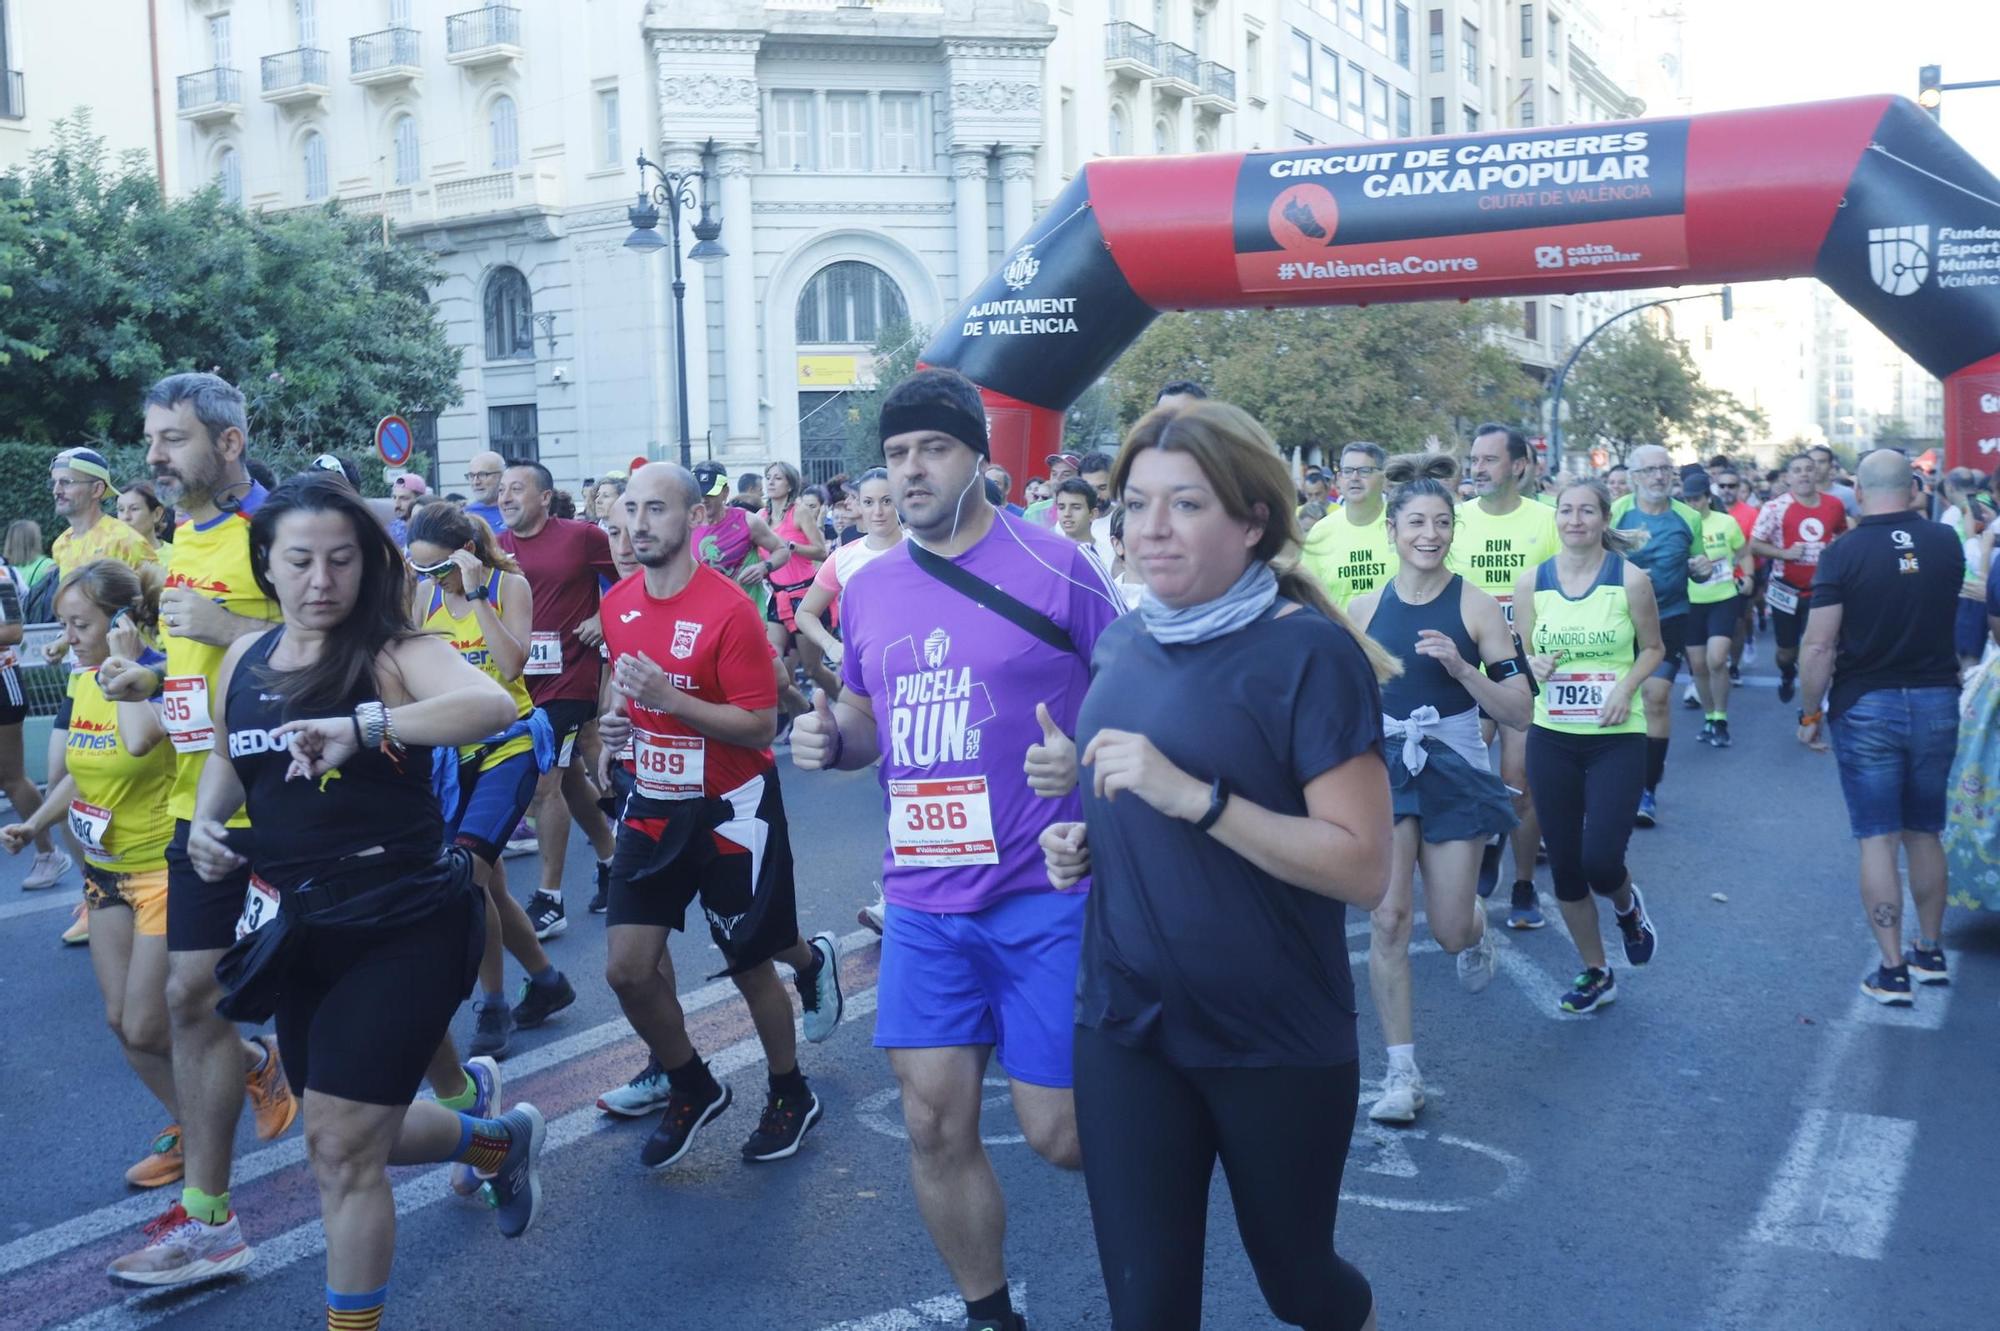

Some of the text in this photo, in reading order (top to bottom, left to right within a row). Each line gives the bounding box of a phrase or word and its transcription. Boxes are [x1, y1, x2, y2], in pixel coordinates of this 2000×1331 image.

[1269, 132, 1648, 178] CIRCUIT DE CARRERES
[1363, 155, 1649, 198] CAIXA POPULAR
[1478, 184, 1651, 210] CIUTAT DE VALÈNCIA
[1938, 226, 2000, 240] Funda
[1566, 244, 1614, 256] caixa
[1567, 252, 1641, 267] popular
[1277, 256, 1478, 280] #ValènciaCorre
[967, 298, 1077, 318] AJUNTAMENT
[962, 316, 1079, 336] DE VALÈNCIA
[1486, 539, 1511, 552] RUN
[1350, 550, 1373, 563] RUN
[1471, 554, 1525, 568] FORREST
[1338, 563, 1386, 578] FORREST
[1485, 570, 1511, 583] RUN
[1351, 578, 1374, 590] RUN
[1588, 630, 1616, 644] SANZ
[893, 667, 971, 707] PUCELA
[164, 696, 191, 721] 95
[891, 700, 970, 768] RUN
[966, 729, 981, 745] 20
[965, 745, 980, 760] 22
[640, 748, 685, 775] 489
[905, 801, 968, 831] 386
